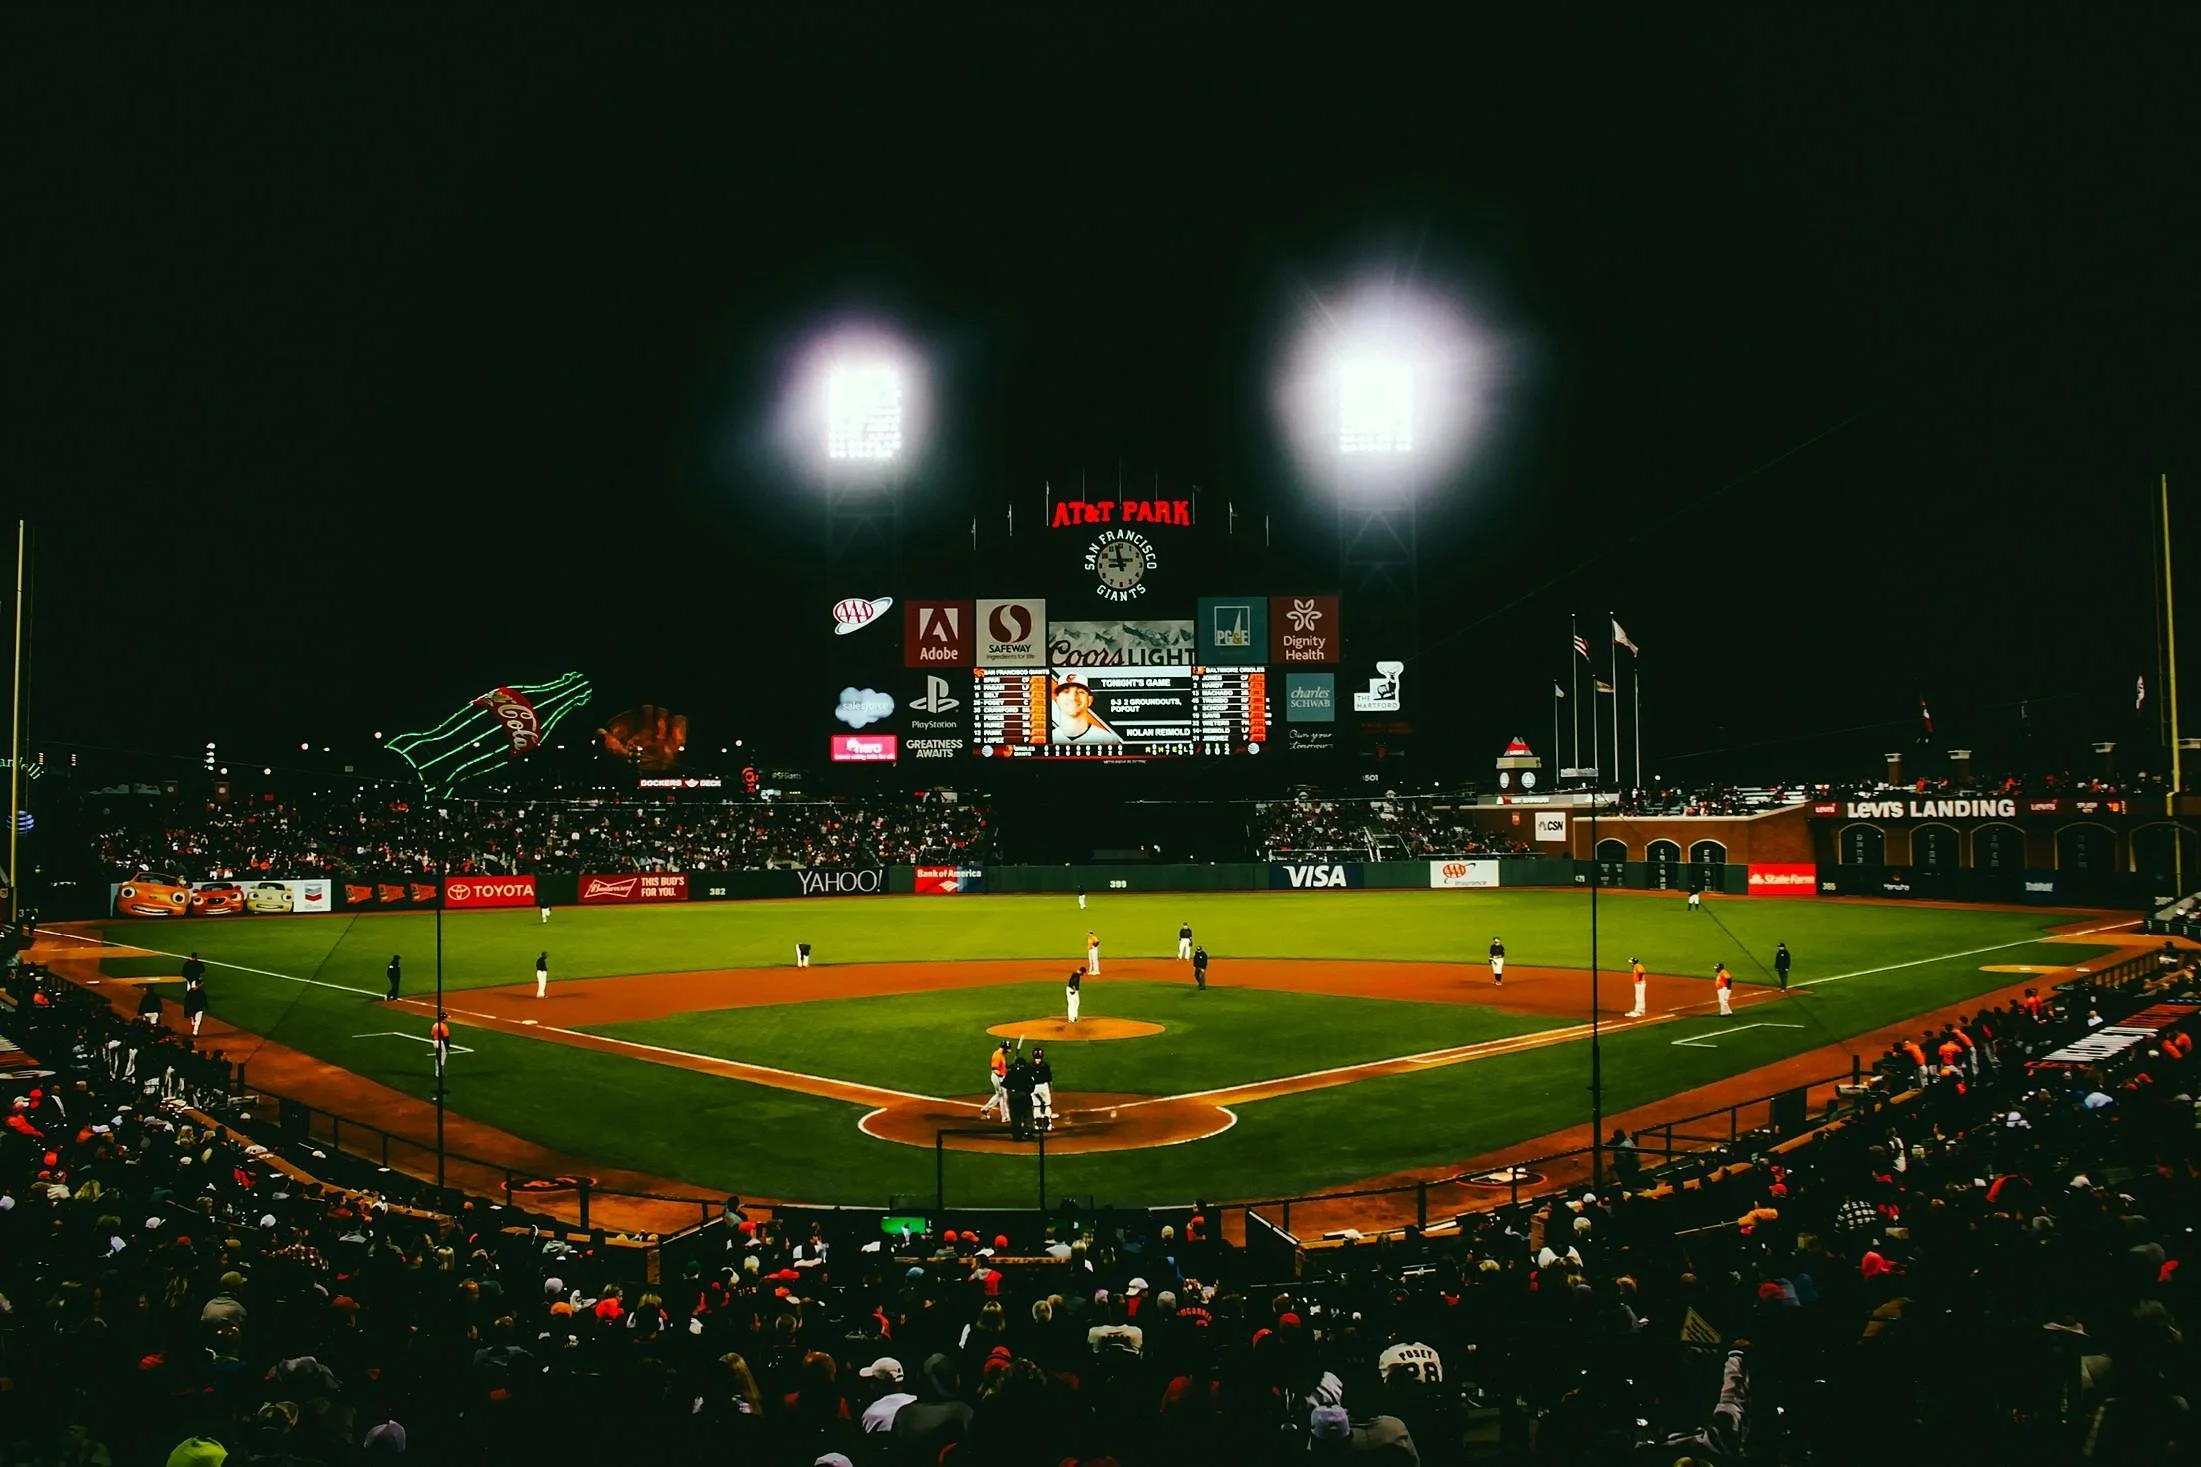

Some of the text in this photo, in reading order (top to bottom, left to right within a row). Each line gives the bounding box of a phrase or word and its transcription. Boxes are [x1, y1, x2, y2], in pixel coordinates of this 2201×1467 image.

[1051, 500, 1191, 529] AT&T PARK
[1084, 528, 1158, 571] SAN FRANCISCO
[1096, 582, 1146, 602] GIANTS
[1217, 629, 1249, 645] PG&E
[1283, 635, 1326, 650] Dignity
[920, 646, 958, 661] Adobe
[989, 644, 1032, 654] SAFEWAY
[1050, 640, 1195, 666] Coors LIGHT
[1286, 649, 1324, 661] Health
[1146, 678, 1171, 687] GAME
[1291, 686, 1330, 699] charles
[1291, 699, 1331, 708] SCHWAB
[498, 704, 539, 750] Cola
[912, 720, 958, 731] PlayStation
[1127, 728, 1154, 737] NOLAN
[906, 739, 963, 750] GREATNESS
[916, 748, 955, 758] AWAITS
[1910, 800, 2016, 818] LANDING
[1548, 821, 1563, 831] CSN
[917, 869, 981, 878] Bank of America
[1283, 865, 1346, 888] VISA
[641, 877, 685, 887] THIS BUD'S
[798, 870, 883, 895] YAHOO!
[475, 884, 535, 898] TOYOTA
[641, 887, 677, 897] FOR YOU.
[1399, 1349, 1432, 1361] POSEY
